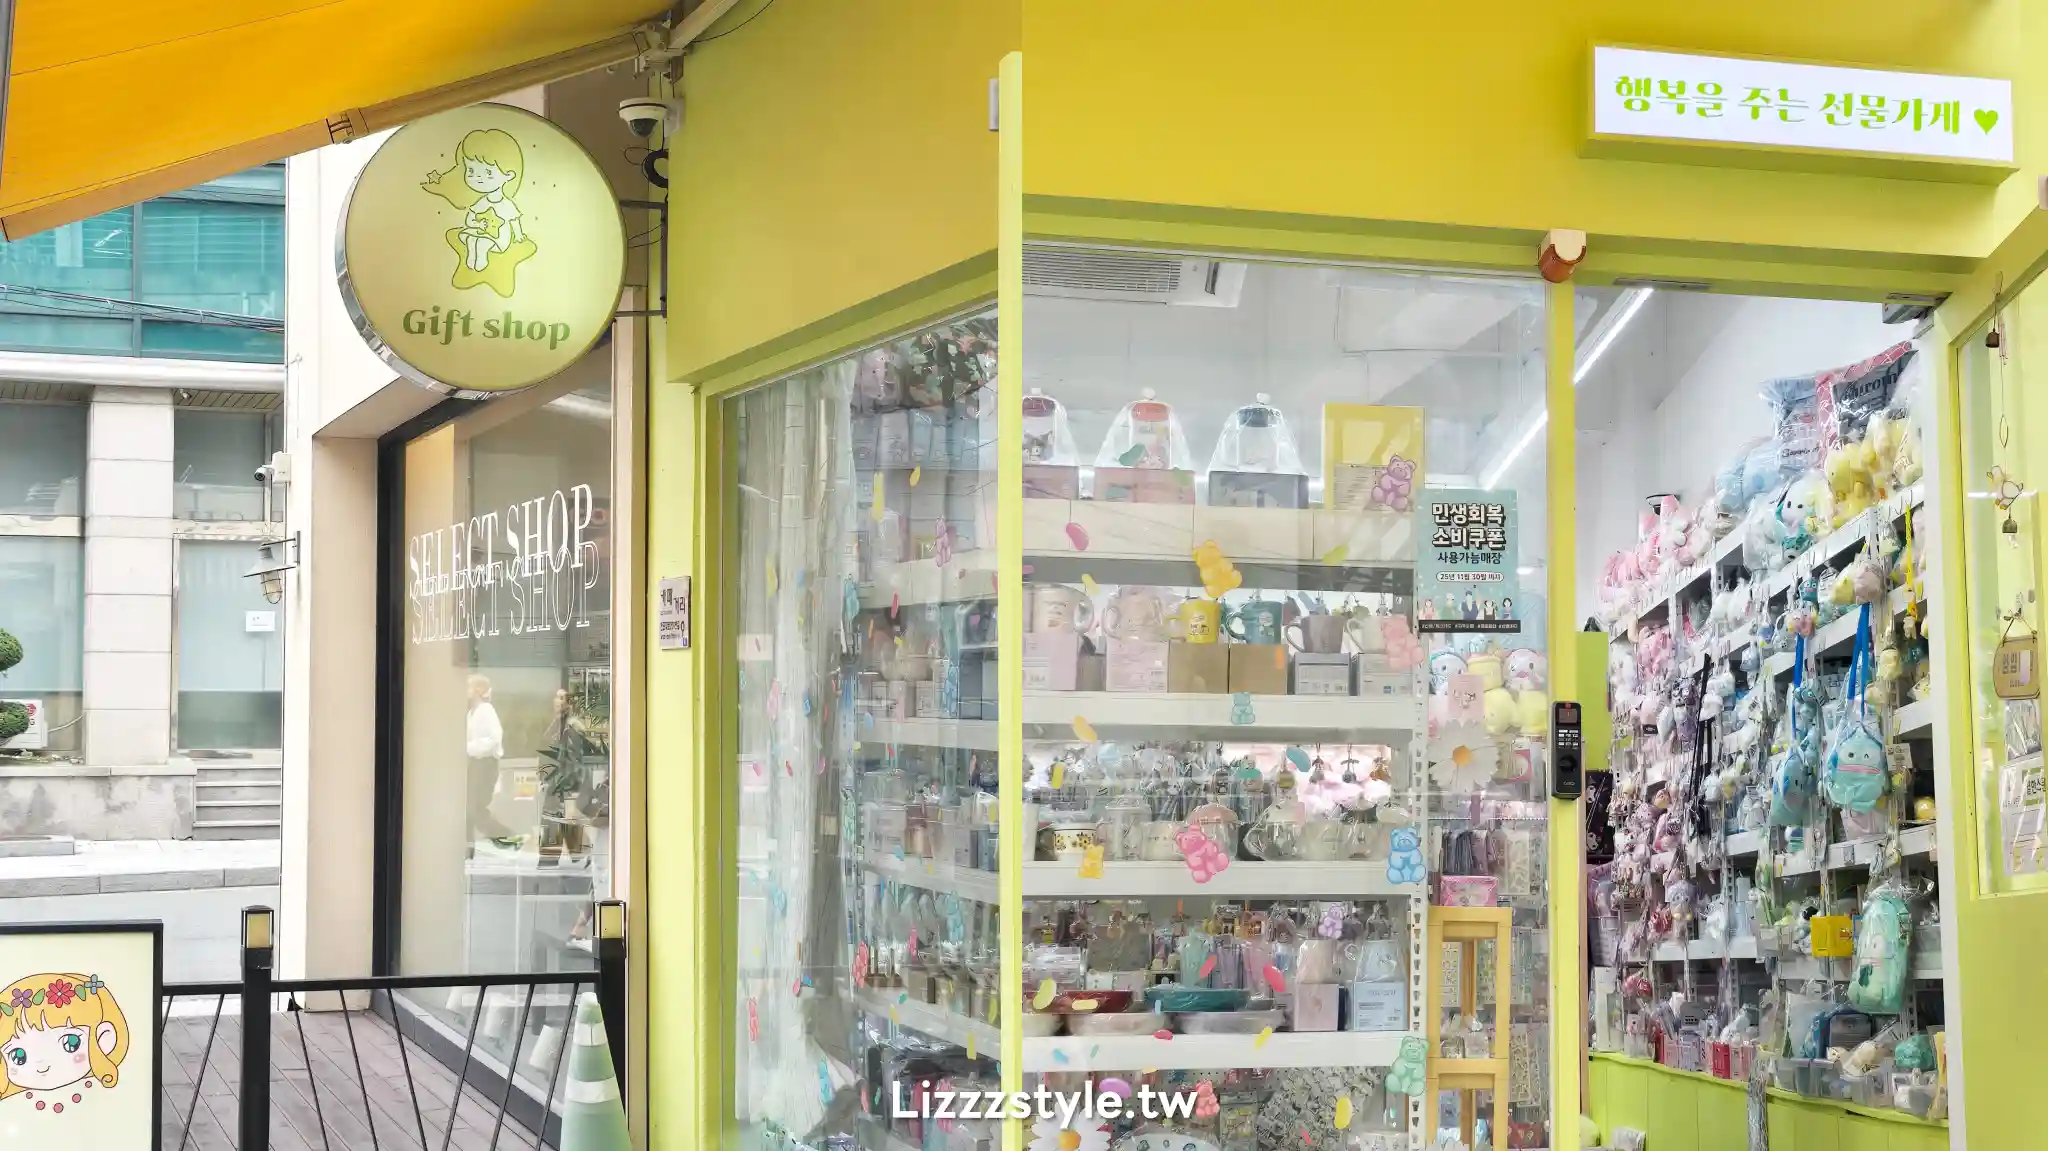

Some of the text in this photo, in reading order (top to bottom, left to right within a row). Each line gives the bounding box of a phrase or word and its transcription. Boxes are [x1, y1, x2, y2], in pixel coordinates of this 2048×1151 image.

[1613, 75, 1961, 135] 행복을 주는 선물가게
[403, 305, 571, 350] Gift shop
[1432, 503, 1506, 527] 민생회복
[409, 484, 593, 597] SELECT SHOP
[1432, 527, 1506, 550] 소비쿠폰
[1437, 552, 1502, 564] 사용가능매장
[506, 540, 600, 635] SHOP
